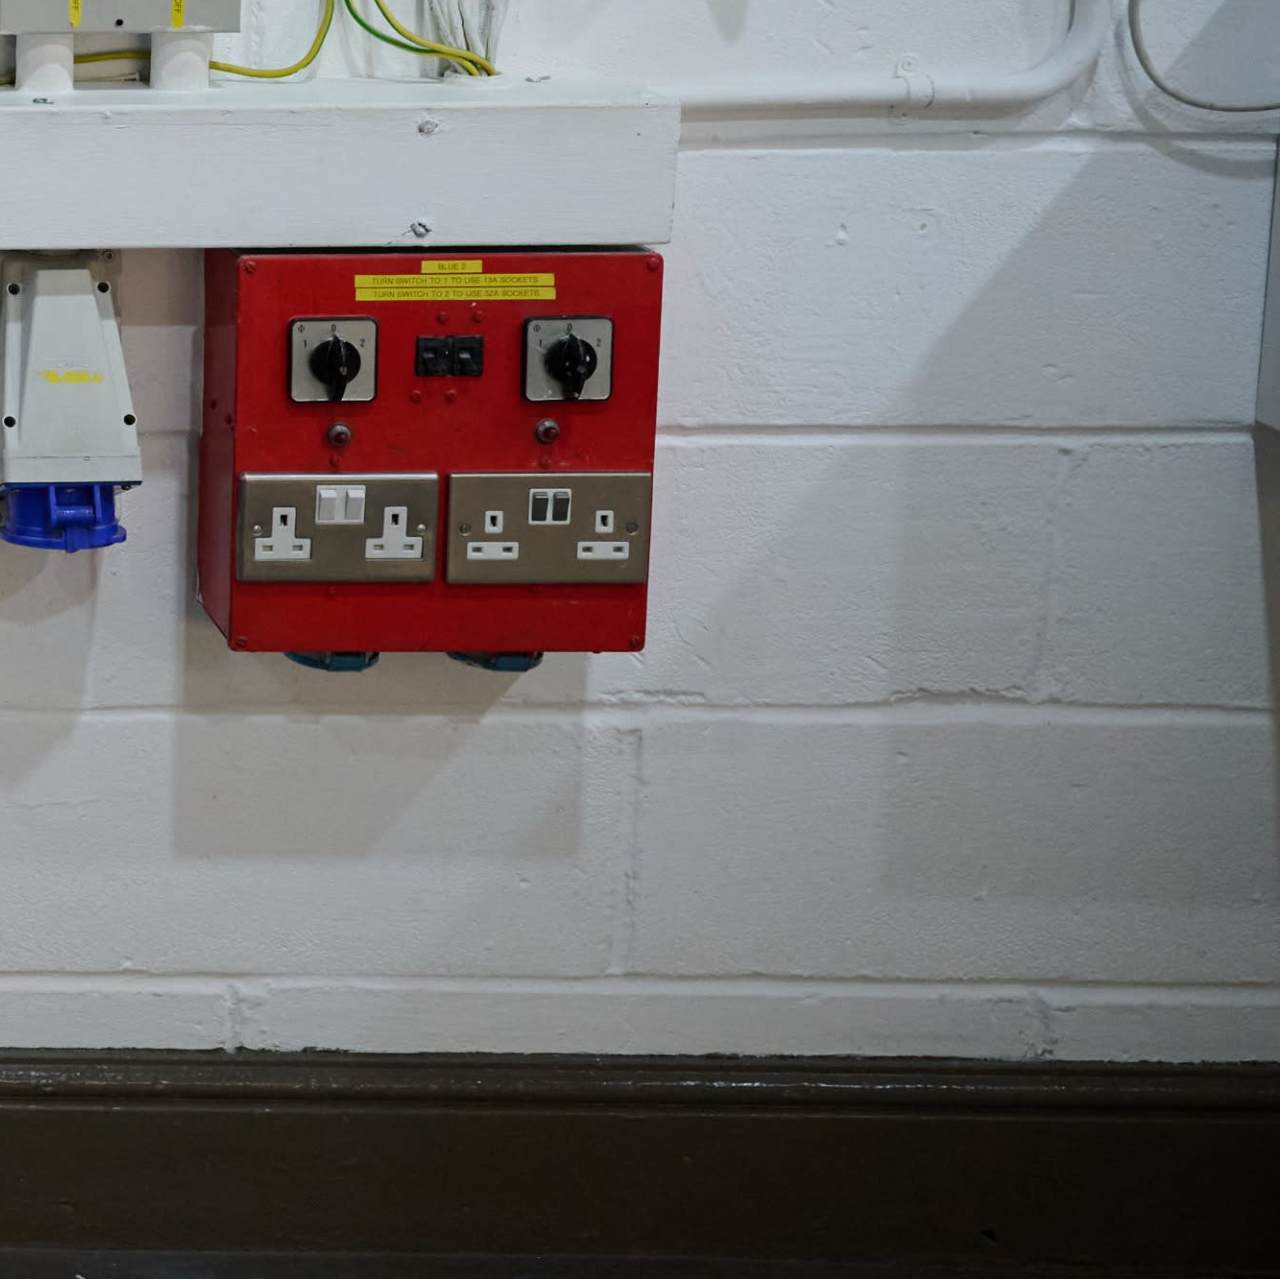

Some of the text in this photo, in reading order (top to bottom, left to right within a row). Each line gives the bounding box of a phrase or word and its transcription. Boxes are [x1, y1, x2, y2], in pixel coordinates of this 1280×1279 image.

[372, 277, 394, 285] TURN
[395, 277, 427, 285] SWITCH
[430, 277, 441, 285] TO
[465, 276, 481, 284] USE
[500, 276, 539, 284] SOCKETS
[373, 291, 395, 299] TURN
[397, 290, 429, 298] SWITCH
[432, 290, 442, 298] TO
[444, 290, 450, 298] 2
[466, 289, 482, 297] USE
[502, 289, 540, 297] SOCKETS
